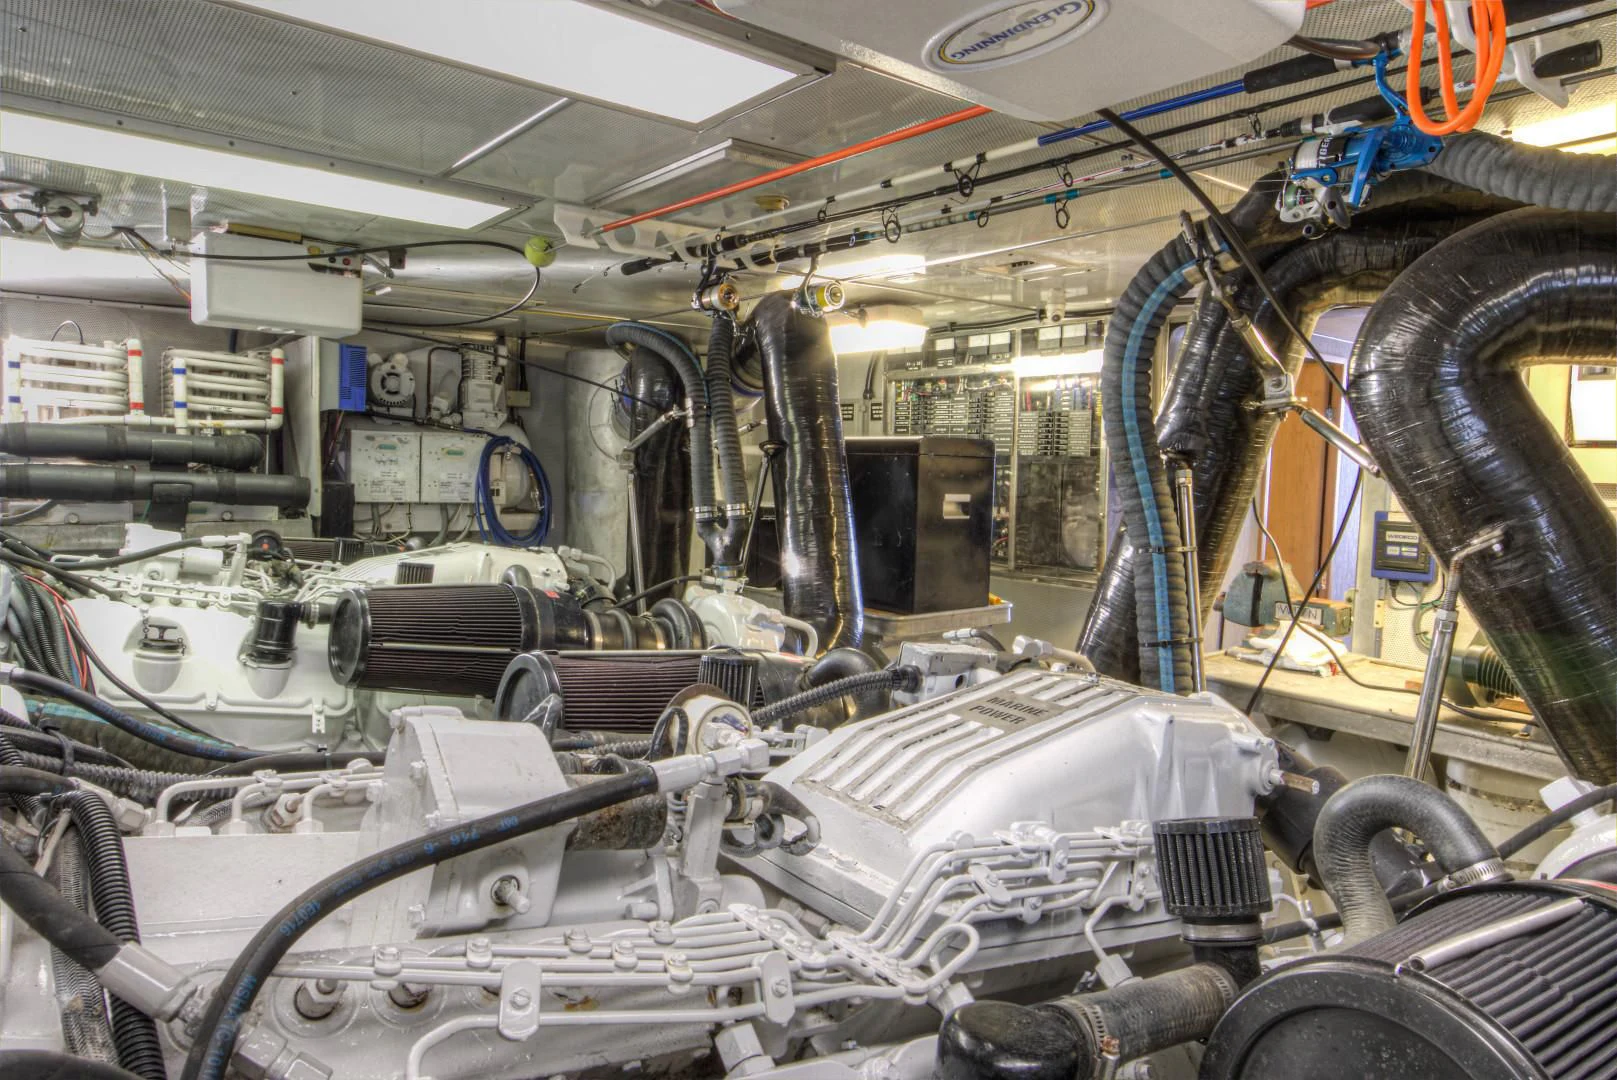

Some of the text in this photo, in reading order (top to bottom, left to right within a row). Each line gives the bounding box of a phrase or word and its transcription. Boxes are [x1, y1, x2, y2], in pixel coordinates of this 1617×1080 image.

[950, 1, 1083, 61] GLENDINNING
[968, 705, 1027, 725] POWER
[986, 696, 1049, 717] MARINE
